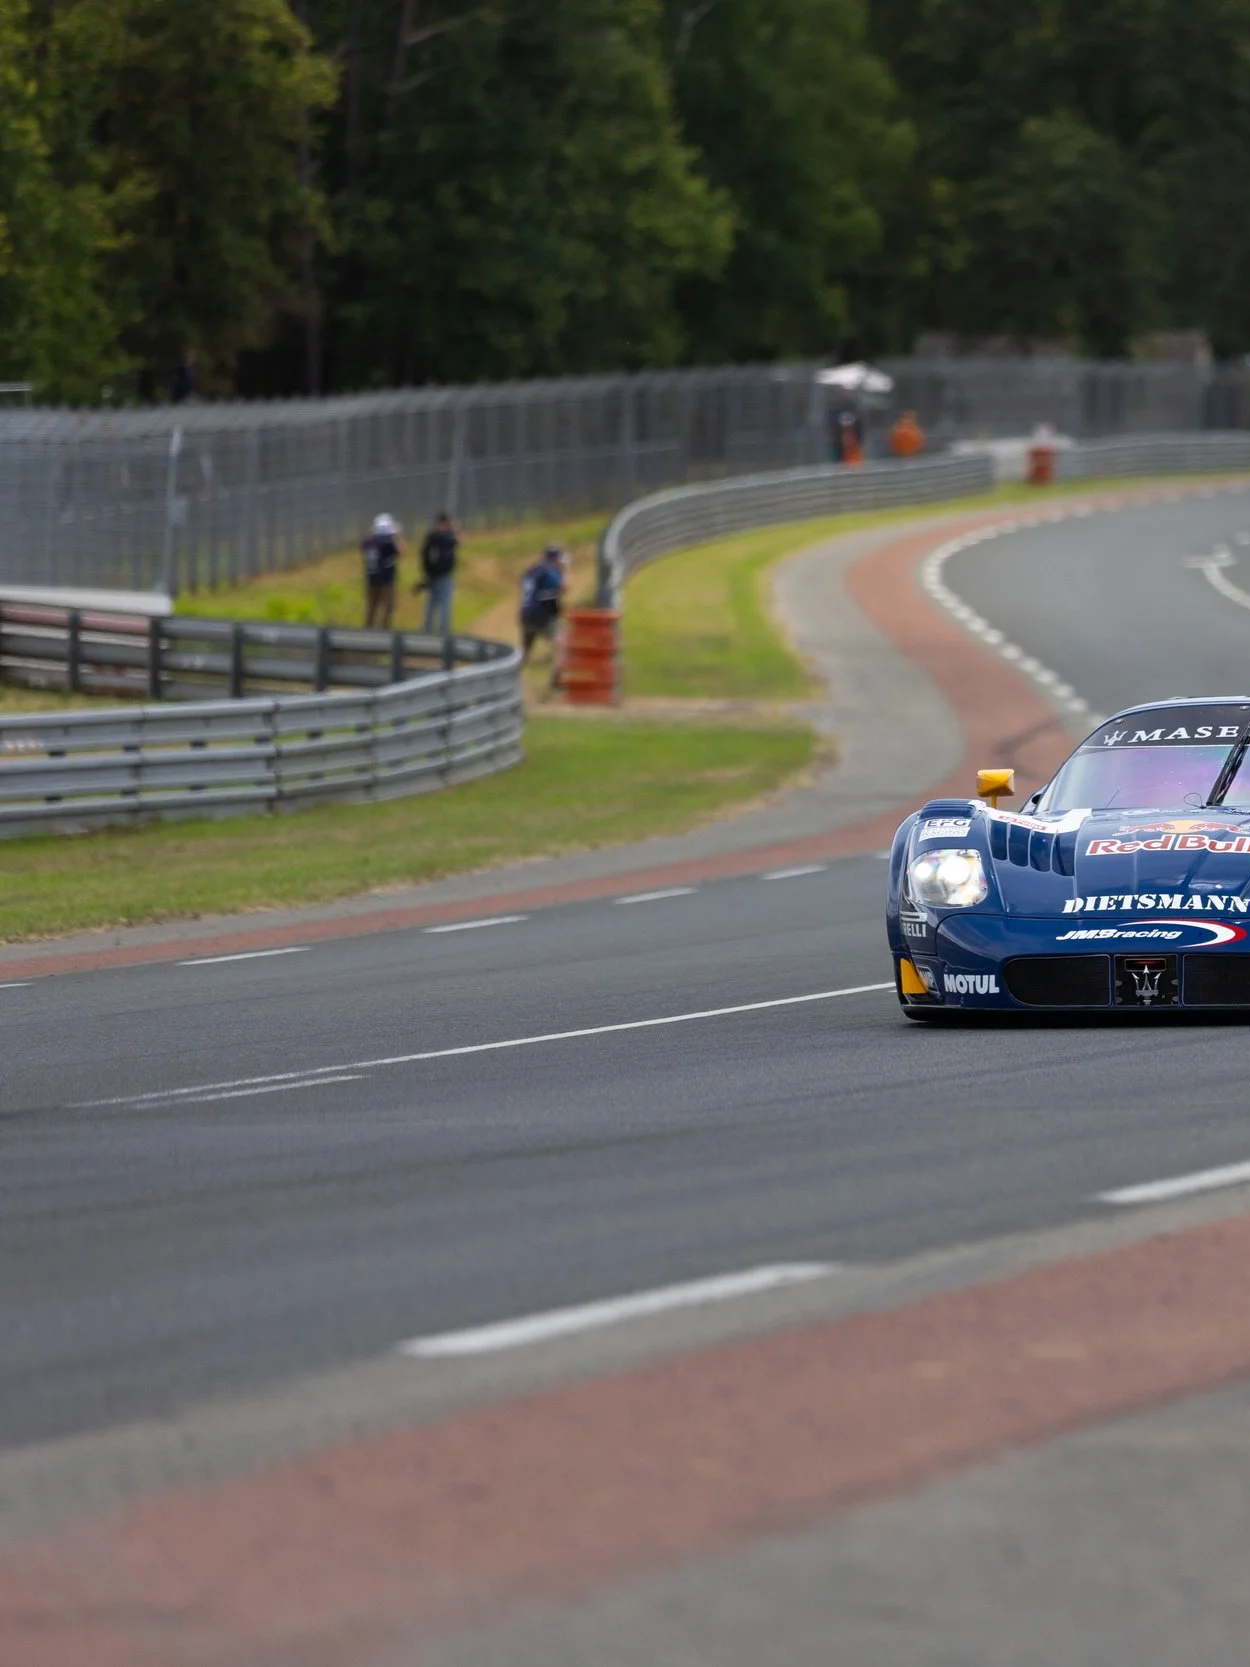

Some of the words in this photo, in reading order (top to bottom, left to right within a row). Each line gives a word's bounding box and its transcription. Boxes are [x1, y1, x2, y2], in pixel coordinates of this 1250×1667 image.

[927, 819, 967, 828] EFG
[1086, 834, 1176, 856] Red
[944, 973, 1000, 994] MOTUL
